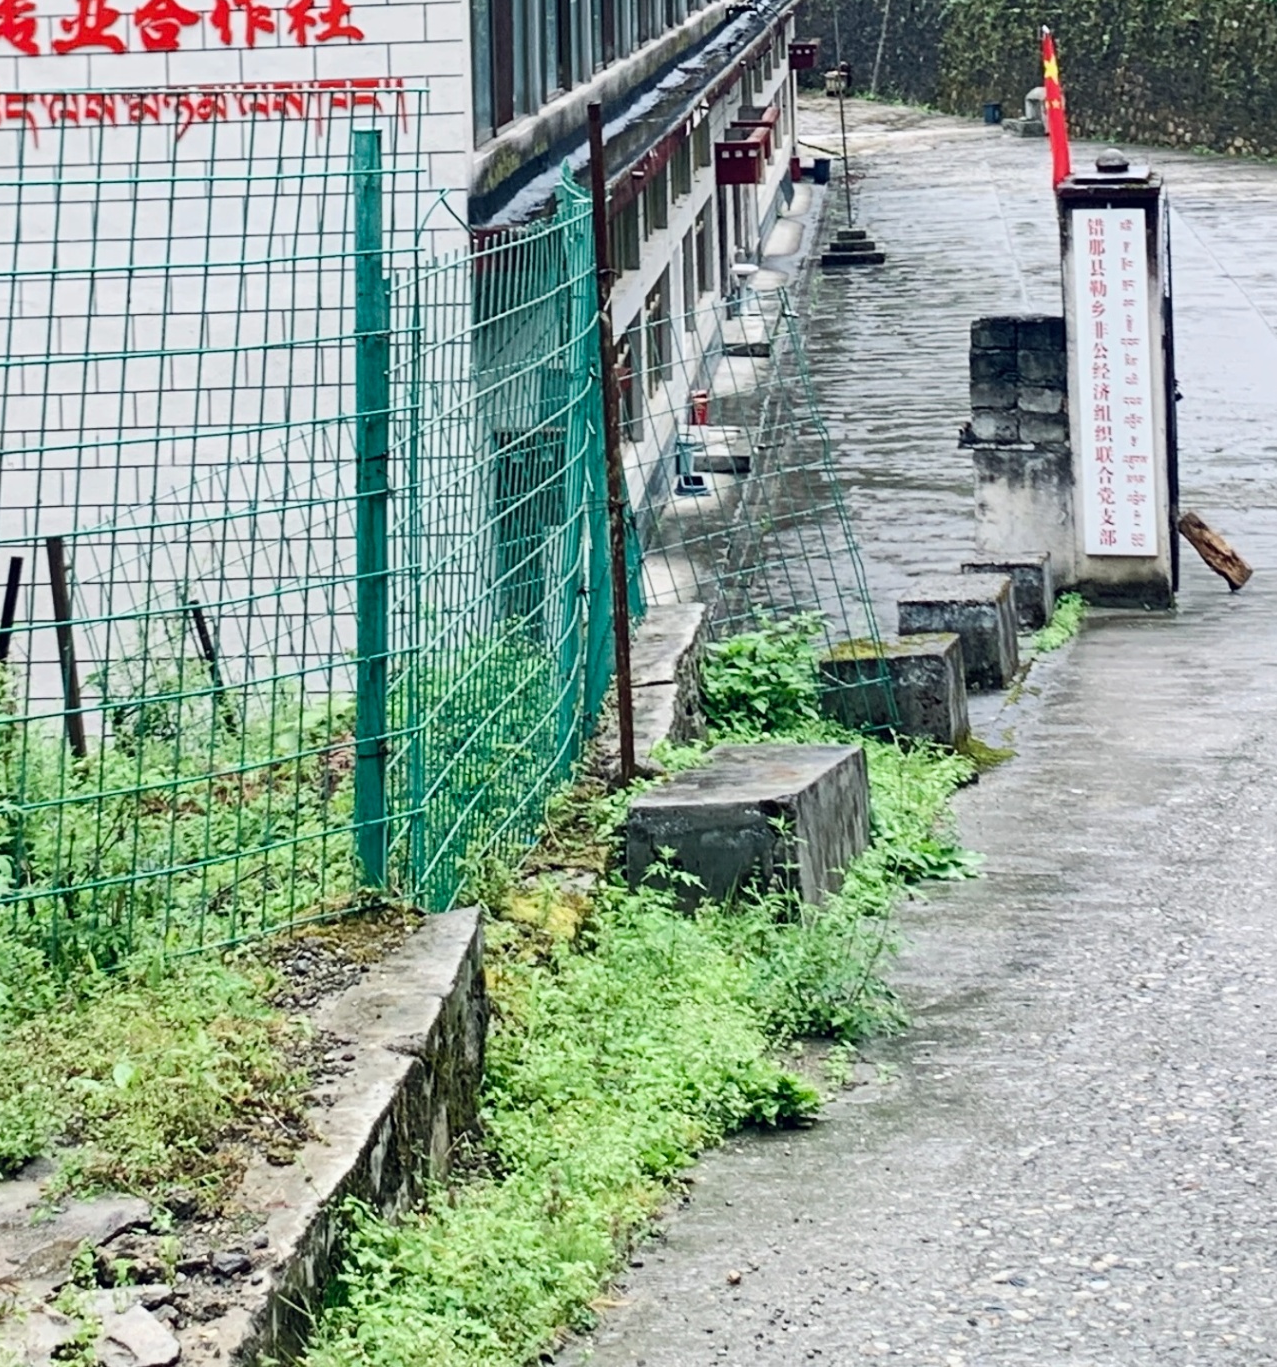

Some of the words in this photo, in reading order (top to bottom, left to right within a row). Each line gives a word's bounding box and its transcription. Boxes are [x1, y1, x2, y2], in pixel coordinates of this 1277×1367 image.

[1087, 217, 1118, 547] 错那县勒乡非公经济组织联合党支部
